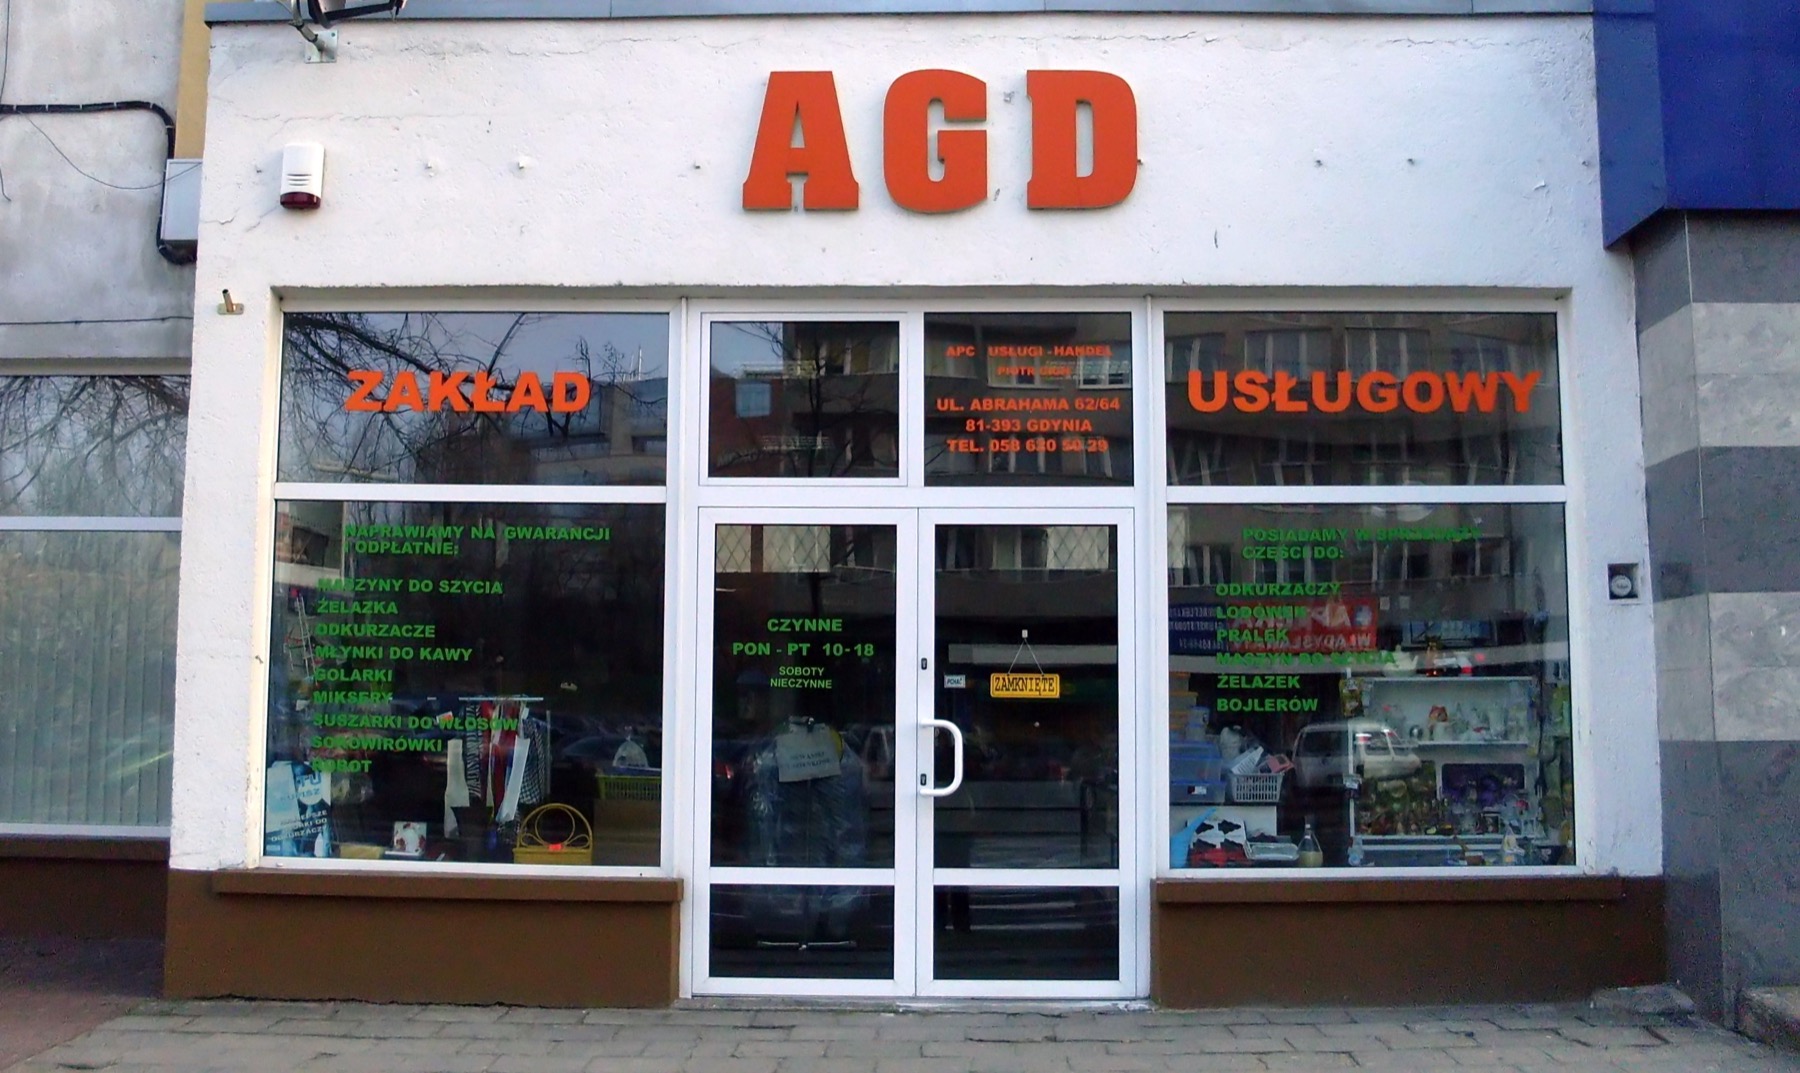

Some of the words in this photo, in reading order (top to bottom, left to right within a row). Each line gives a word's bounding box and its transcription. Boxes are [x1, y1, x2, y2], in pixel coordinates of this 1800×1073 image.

[743, 69, 1138, 213] AGD
[945, 346, 976, 357] APC
[987, 346, 1043, 357] USŁUGI
[1055, 346, 1113, 357] HANDEL
[344, 370, 591, 413] ZAKŁAD
[1187, 370, 1542, 414] USŁUGOWY
[936, 398, 964, 411] UL.
[970, 398, 1069, 411] ABRAHAMA
[1074, 397, 1120, 411] 62/64
[965, 419, 1021, 432] 81-393
[1027, 419, 1093, 432] GDYNIA
[947, 439, 984, 452] TEL.
[989, 439, 1020, 452] 058
[346, 525, 464, 540] NAPRAWIAMY
[471, 526, 495, 540] NA
[504, 527, 611, 541] GWARANCJI
[1242, 528, 1348, 542] POSIADAMY
[355, 541, 459, 556] ODPŁATNIE:
[1313, 547, 1344, 560] DO:
[318, 578, 402, 592] MASZYNY
[409, 579, 433, 593] DO
[439, 580, 504, 595] SZYCIA
[1216, 582, 1342, 598] ODKURZACZY
[317, 600, 399, 615] ŻELAZKA
[316, 623, 436, 638] ODKURZACZE
[767, 618, 843, 632] CZYNNE
[1217, 628, 1289, 643] PRALEK
[315, 645, 385, 660] MŁYNKI
[389, 646, 414, 661] DO
[420, 647, 473, 662] KAWY
[732, 642, 771, 655] PON
[788, 643, 810, 656] PT
[823, 643, 874, 657] 10-18
[314, 668, 393, 683] GOLARKI
[779, 667, 824, 677] SOBOTY
[770, 679, 832, 689] NIECZYNNE
[995, 677, 1055, 696] ZAMKNIĘTE
[1217, 674, 1300, 689] ŻELAZEK
[313, 690, 393, 704] MIKSERY
[1217, 697, 1318, 712] BOJLERÓW
[313, 713, 402, 728] SUSZARKI
[408, 715, 433, 729] DO
[439, 714, 518, 731] WŁOSÓW
